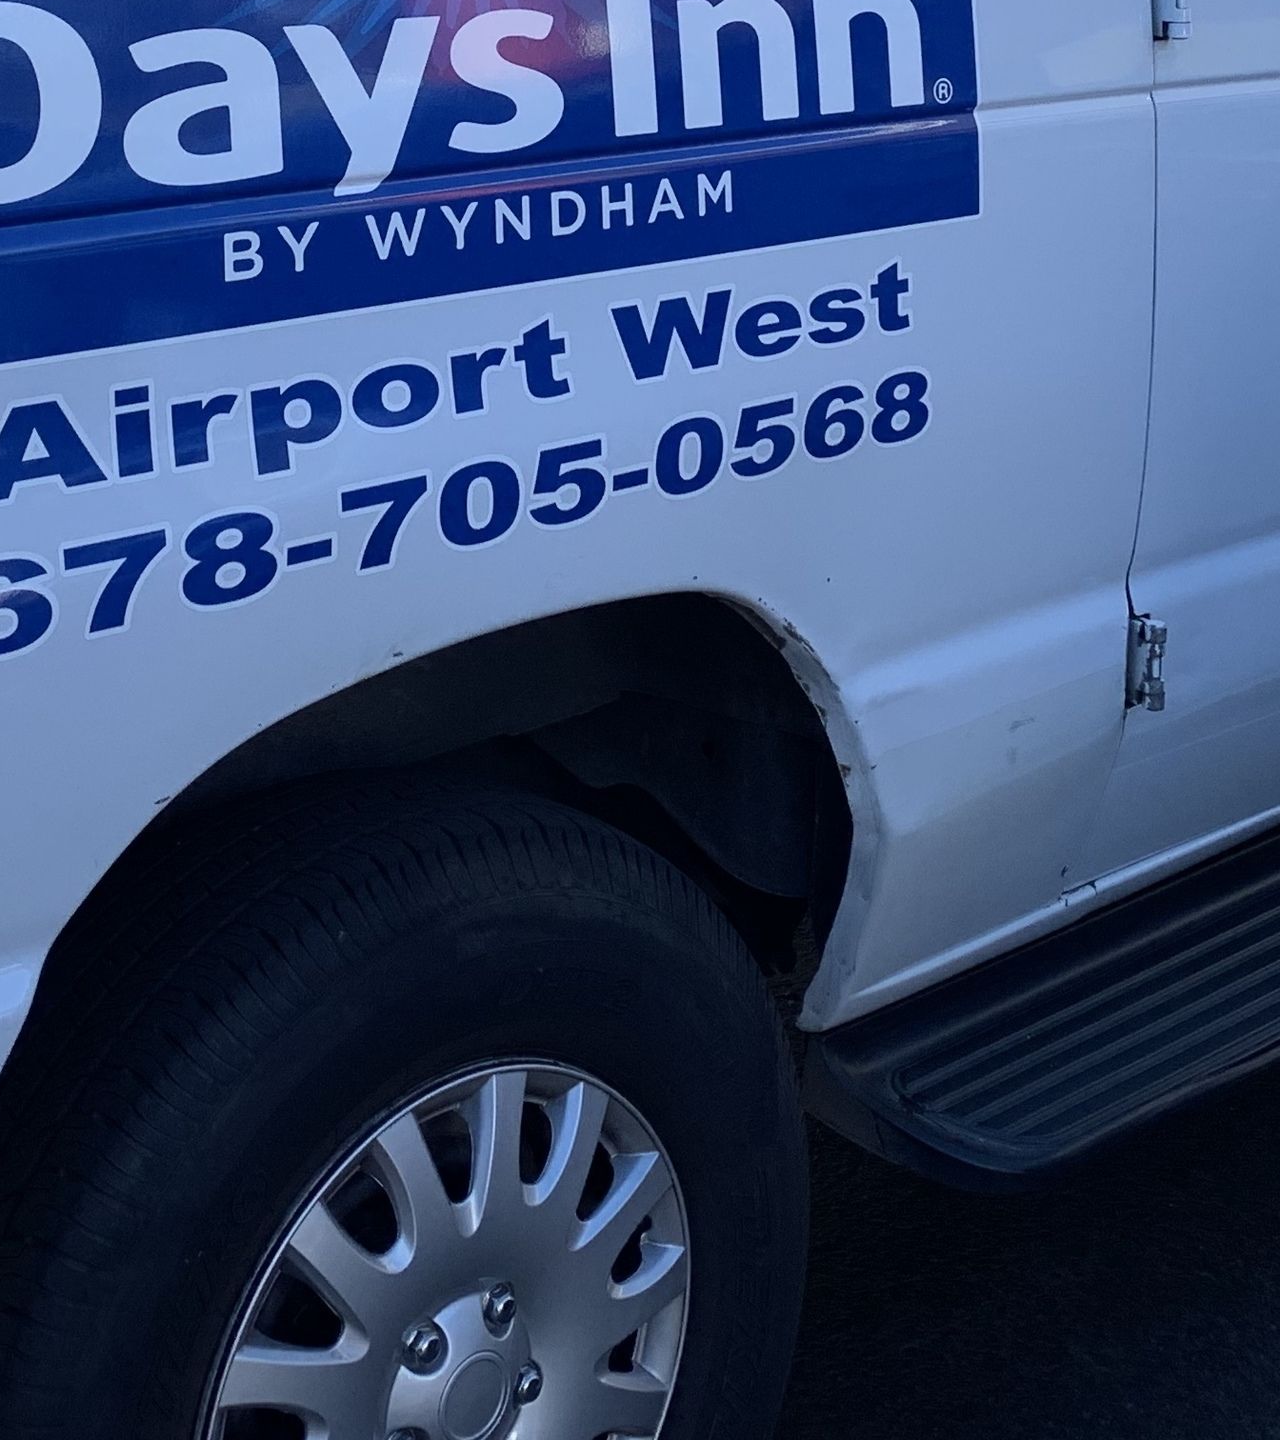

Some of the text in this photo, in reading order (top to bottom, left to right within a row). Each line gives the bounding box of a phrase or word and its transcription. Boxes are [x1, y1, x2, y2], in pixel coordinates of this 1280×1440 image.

[223, 170, 734, 283] BY WYNDHAM
[611, 262, 910, 380] West
